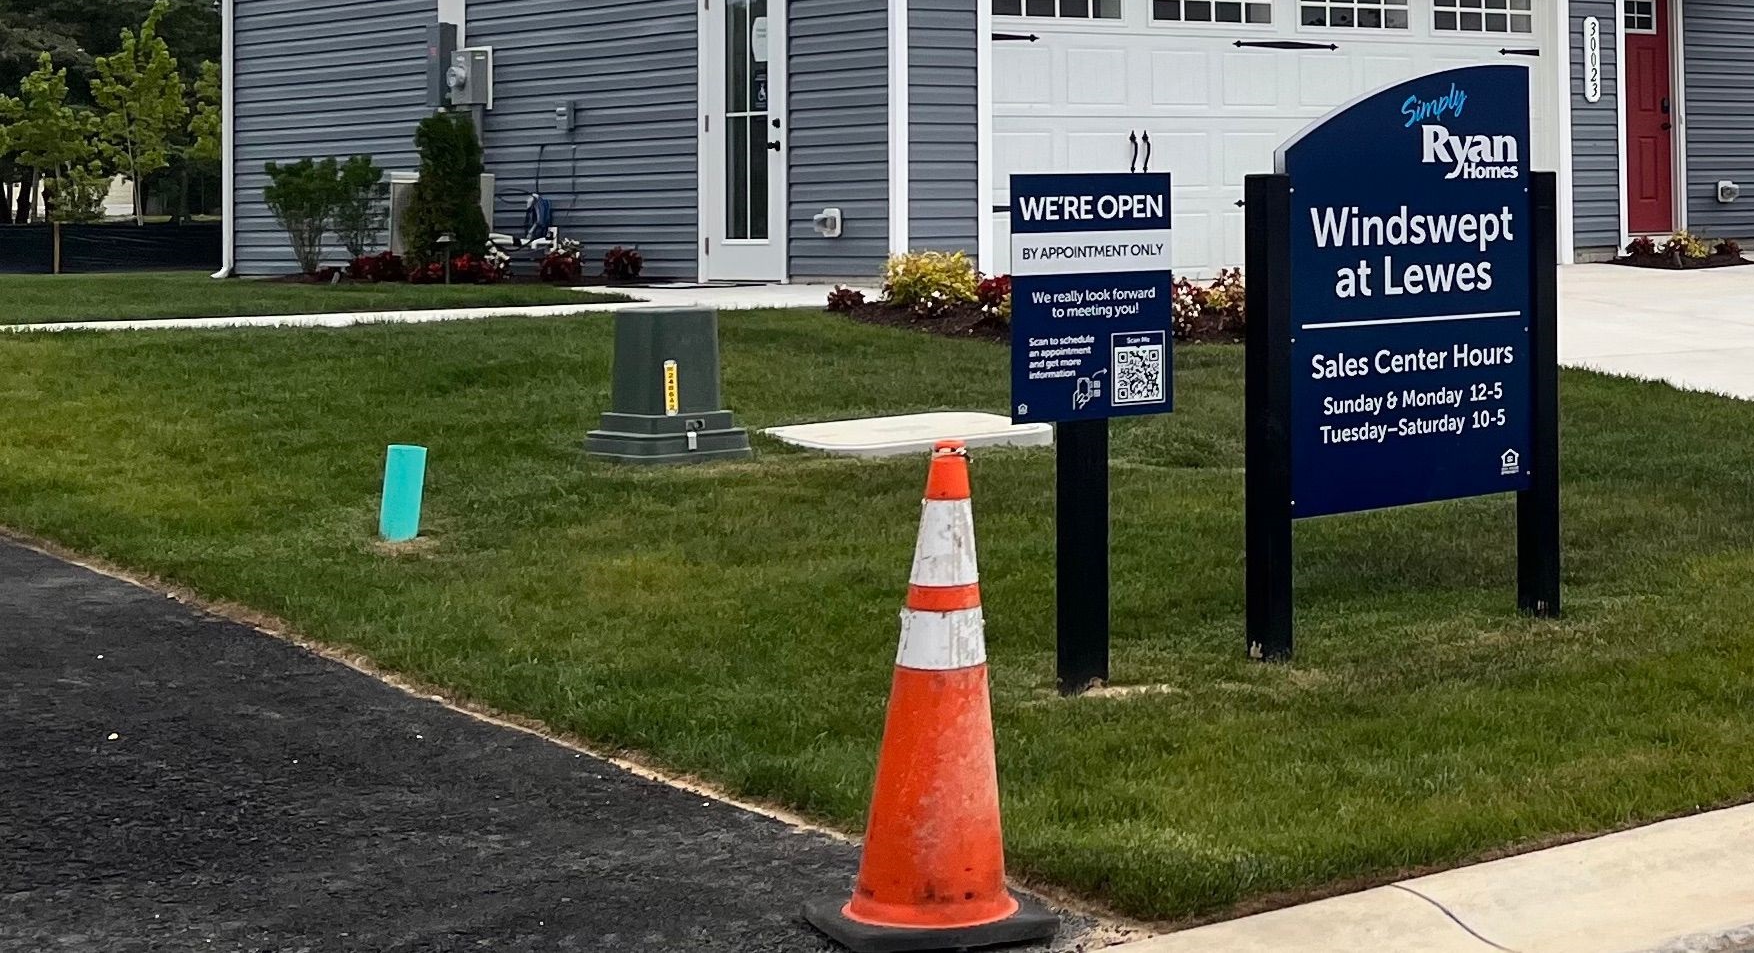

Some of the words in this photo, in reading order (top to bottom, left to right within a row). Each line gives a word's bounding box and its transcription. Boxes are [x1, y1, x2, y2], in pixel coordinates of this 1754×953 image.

[1589, 21, 1598, 97] 30023
[1401, 82, 1467, 127] Simply
[1421, 124, 1518, 179] Ryan
[1463, 162, 1519, 179] Homes
[1019, 196, 1093, 221] WE'RE
[1097, 194, 1163, 219] OPEN
[1310, 205, 1513, 252] Windswept
[1022, 247, 1038, 260] BY
[1040, 245, 1129, 260] APPOINTMENT
[1131, 243, 1163, 257] ONLY
[1335, 260, 1372, 298] at
[1384, 256, 1492, 296] Lewes
[1032, 291, 1051, 304] We
[1053, 290, 1083, 305] really
[1085, 289, 1111, 301] look
[1112, 286, 1156, 300] forward
[1052, 307, 1065, 318] to
[1066, 304, 1113, 318] meeting
[1114, 302, 1139, 318] you!
[1029, 337, 1048, 346] Scan
[1049, 337, 1059, 345] to
[1060, 335, 1095, 345] schedule
[1041, 346, 1091, 358] appointment
[1311, 352, 1369, 379] Sales
[1374, 349, 1447, 374] Center
[1453, 343, 1514, 368] Hours
[1029, 359, 1044, 369] and
[1046, 359, 1059, 369] get
[1060, 358, 1081, 366] more
[1029, 369, 1076, 379] information
[1323, 394, 1382, 415] Sunday
[1387, 391, 1398, 409] &
[1402, 387, 1463, 408] Monday
[1469, 382, 1503, 402] 12-5
[1472, 409, 1506, 429] 10-5
